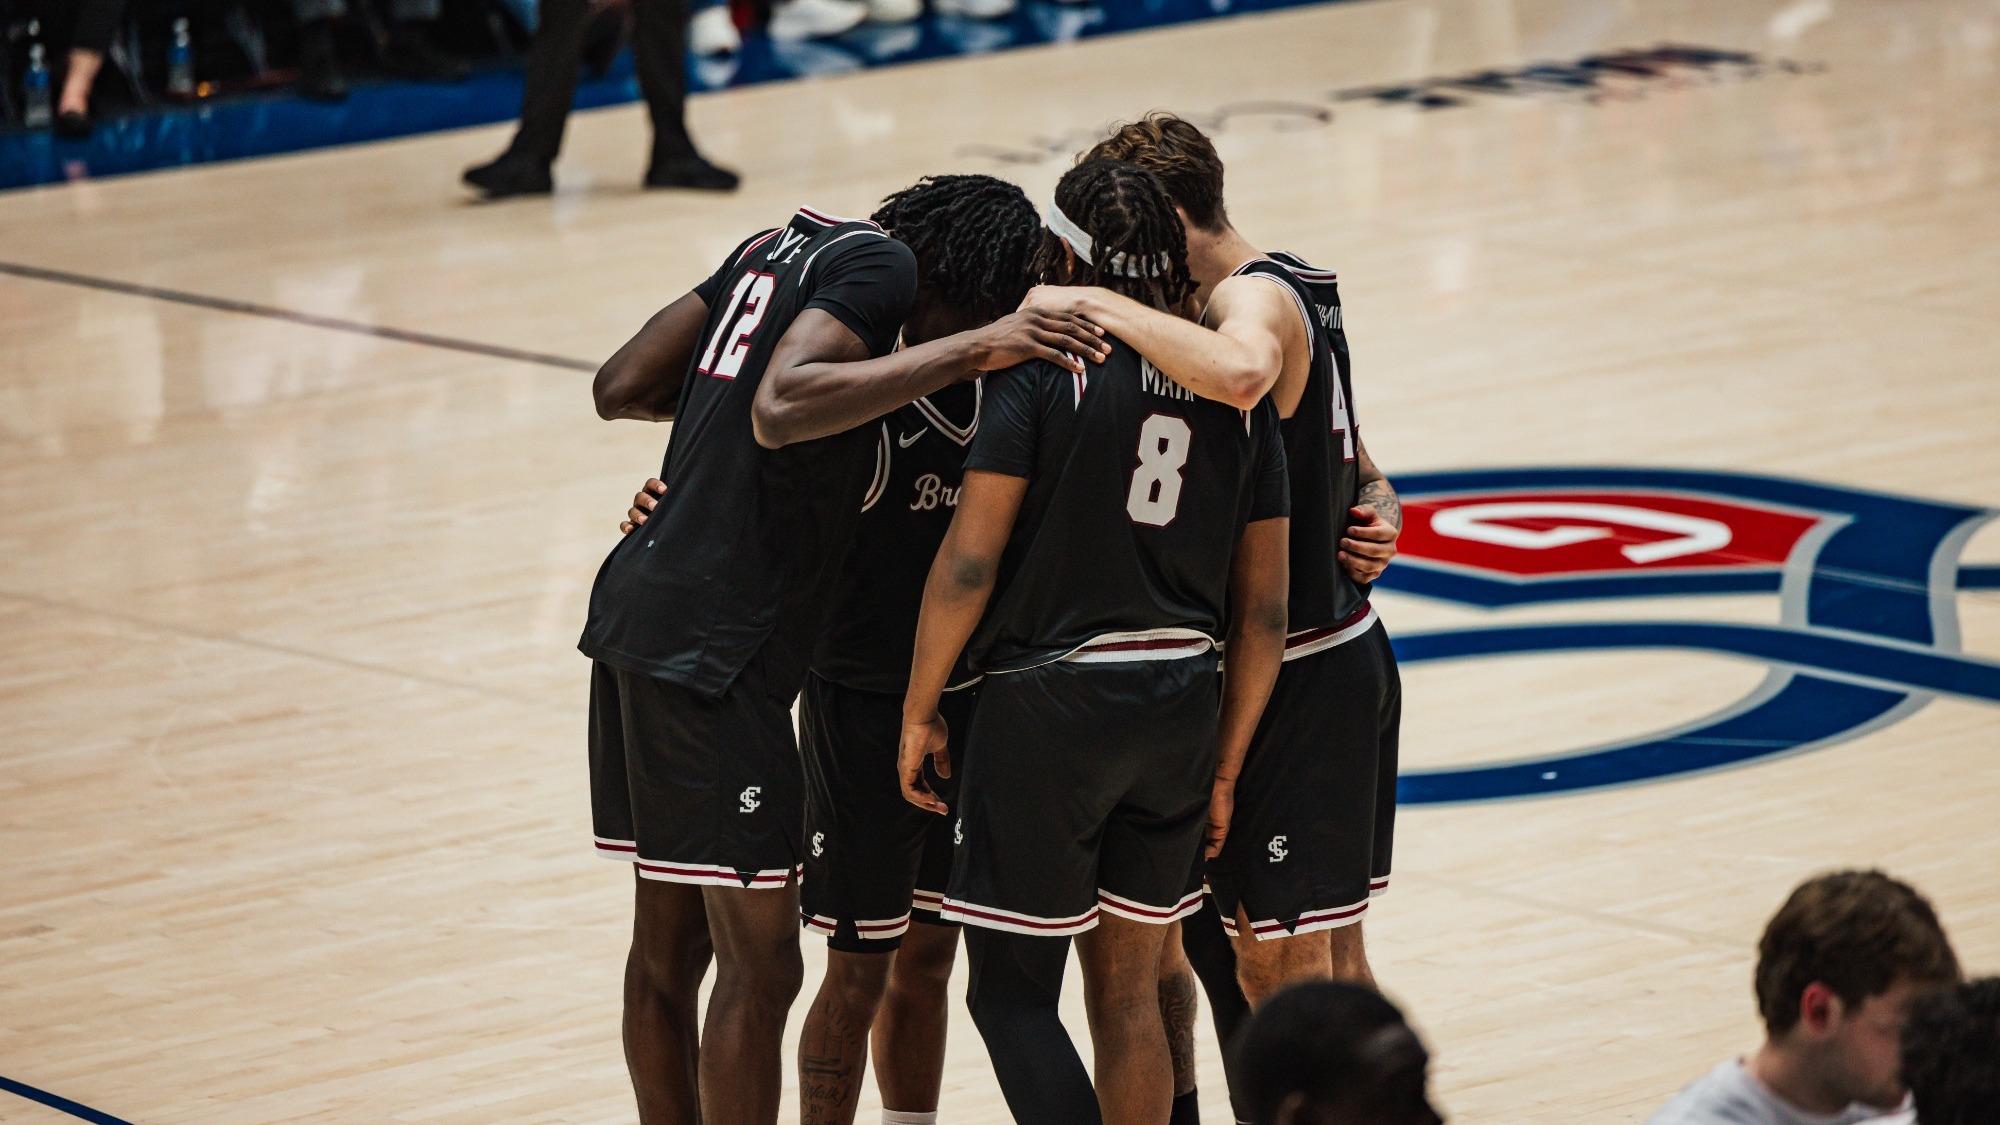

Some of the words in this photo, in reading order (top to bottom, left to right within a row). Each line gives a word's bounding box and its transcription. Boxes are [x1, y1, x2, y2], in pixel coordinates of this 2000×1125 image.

[698, 269, 775, 380] 12
[1331, 349, 1360, 462] 4
[1126, 411, 1193, 528] 8
